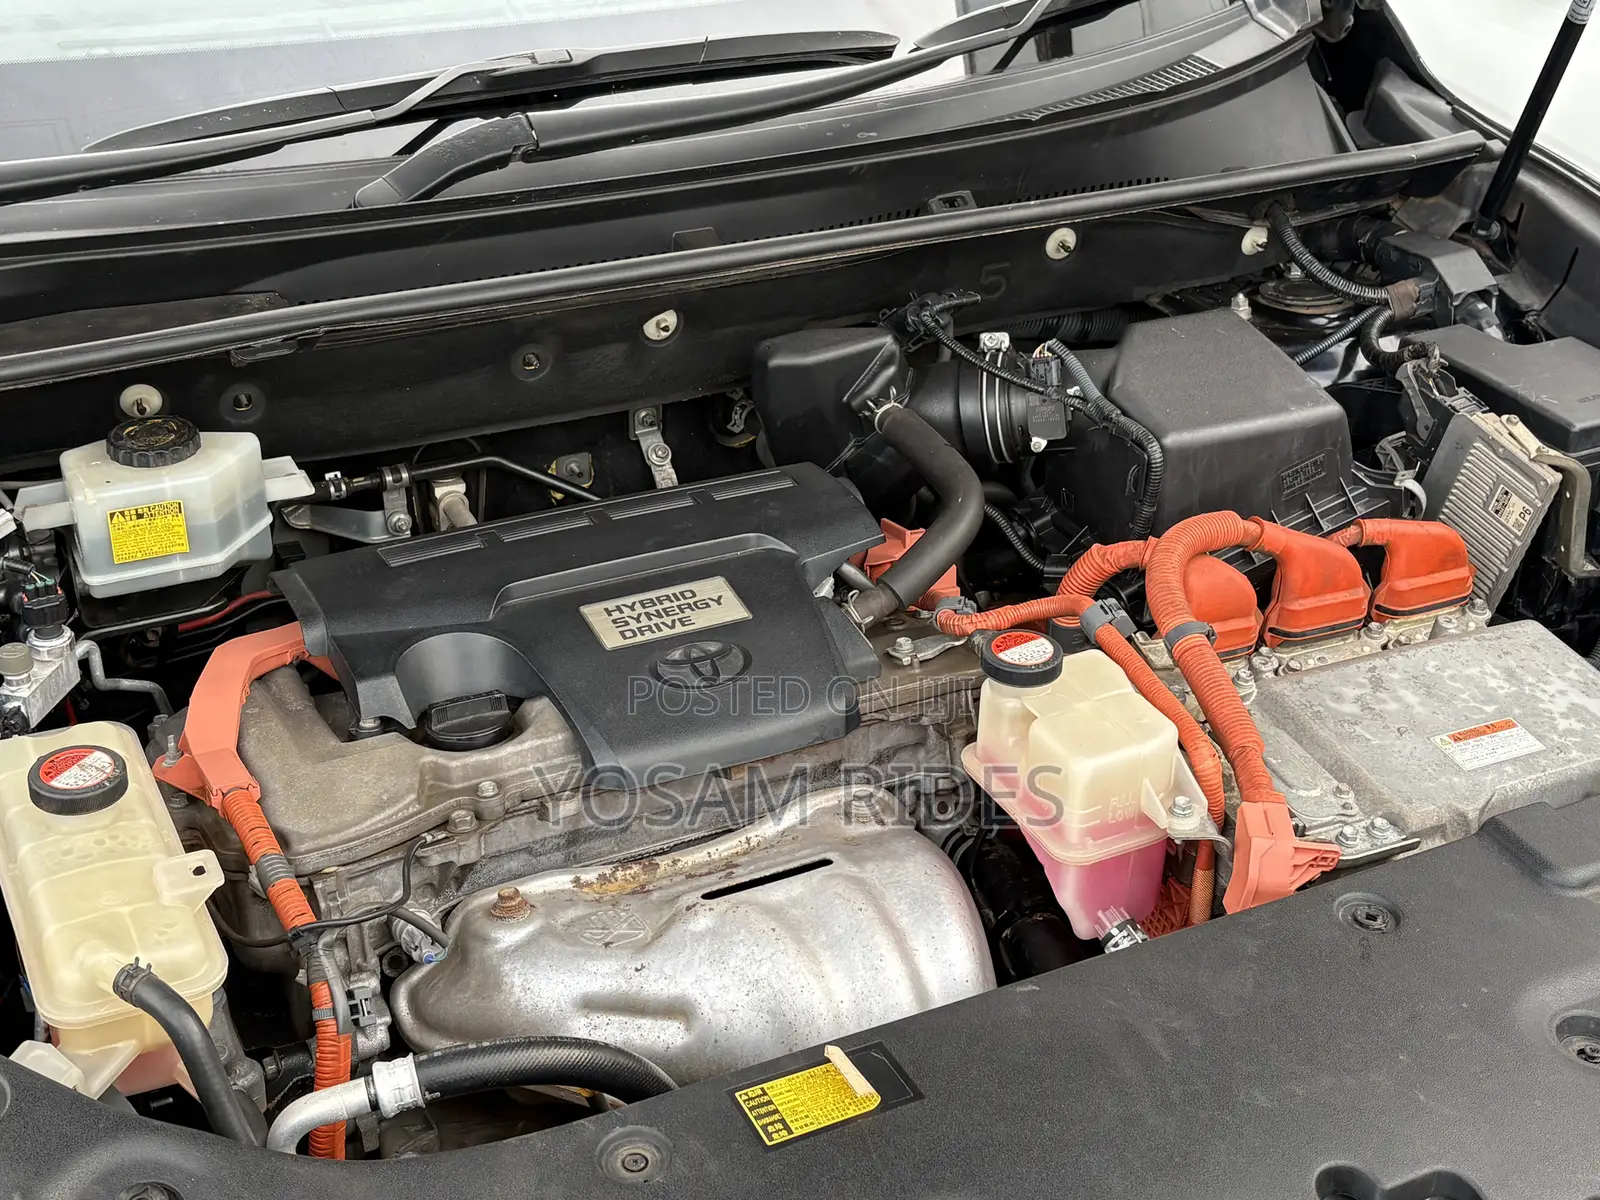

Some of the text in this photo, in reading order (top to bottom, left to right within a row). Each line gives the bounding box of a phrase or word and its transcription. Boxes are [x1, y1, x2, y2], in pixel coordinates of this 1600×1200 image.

[980, 262, 1010, 299] 5
[150, 502, 179, 512] CAUTION
[1519, 506, 1532, 522] P6
[604, 589, 696, 616] HYBRID
[611, 595, 723, 628] SYNERGY
[619, 616, 695, 640] DRIVE
[1108, 808, 1137, 824] LOW
[745, 1095, 771, 1108] CAUTION
[751, 1104, 777, 1117] ATTENTION
